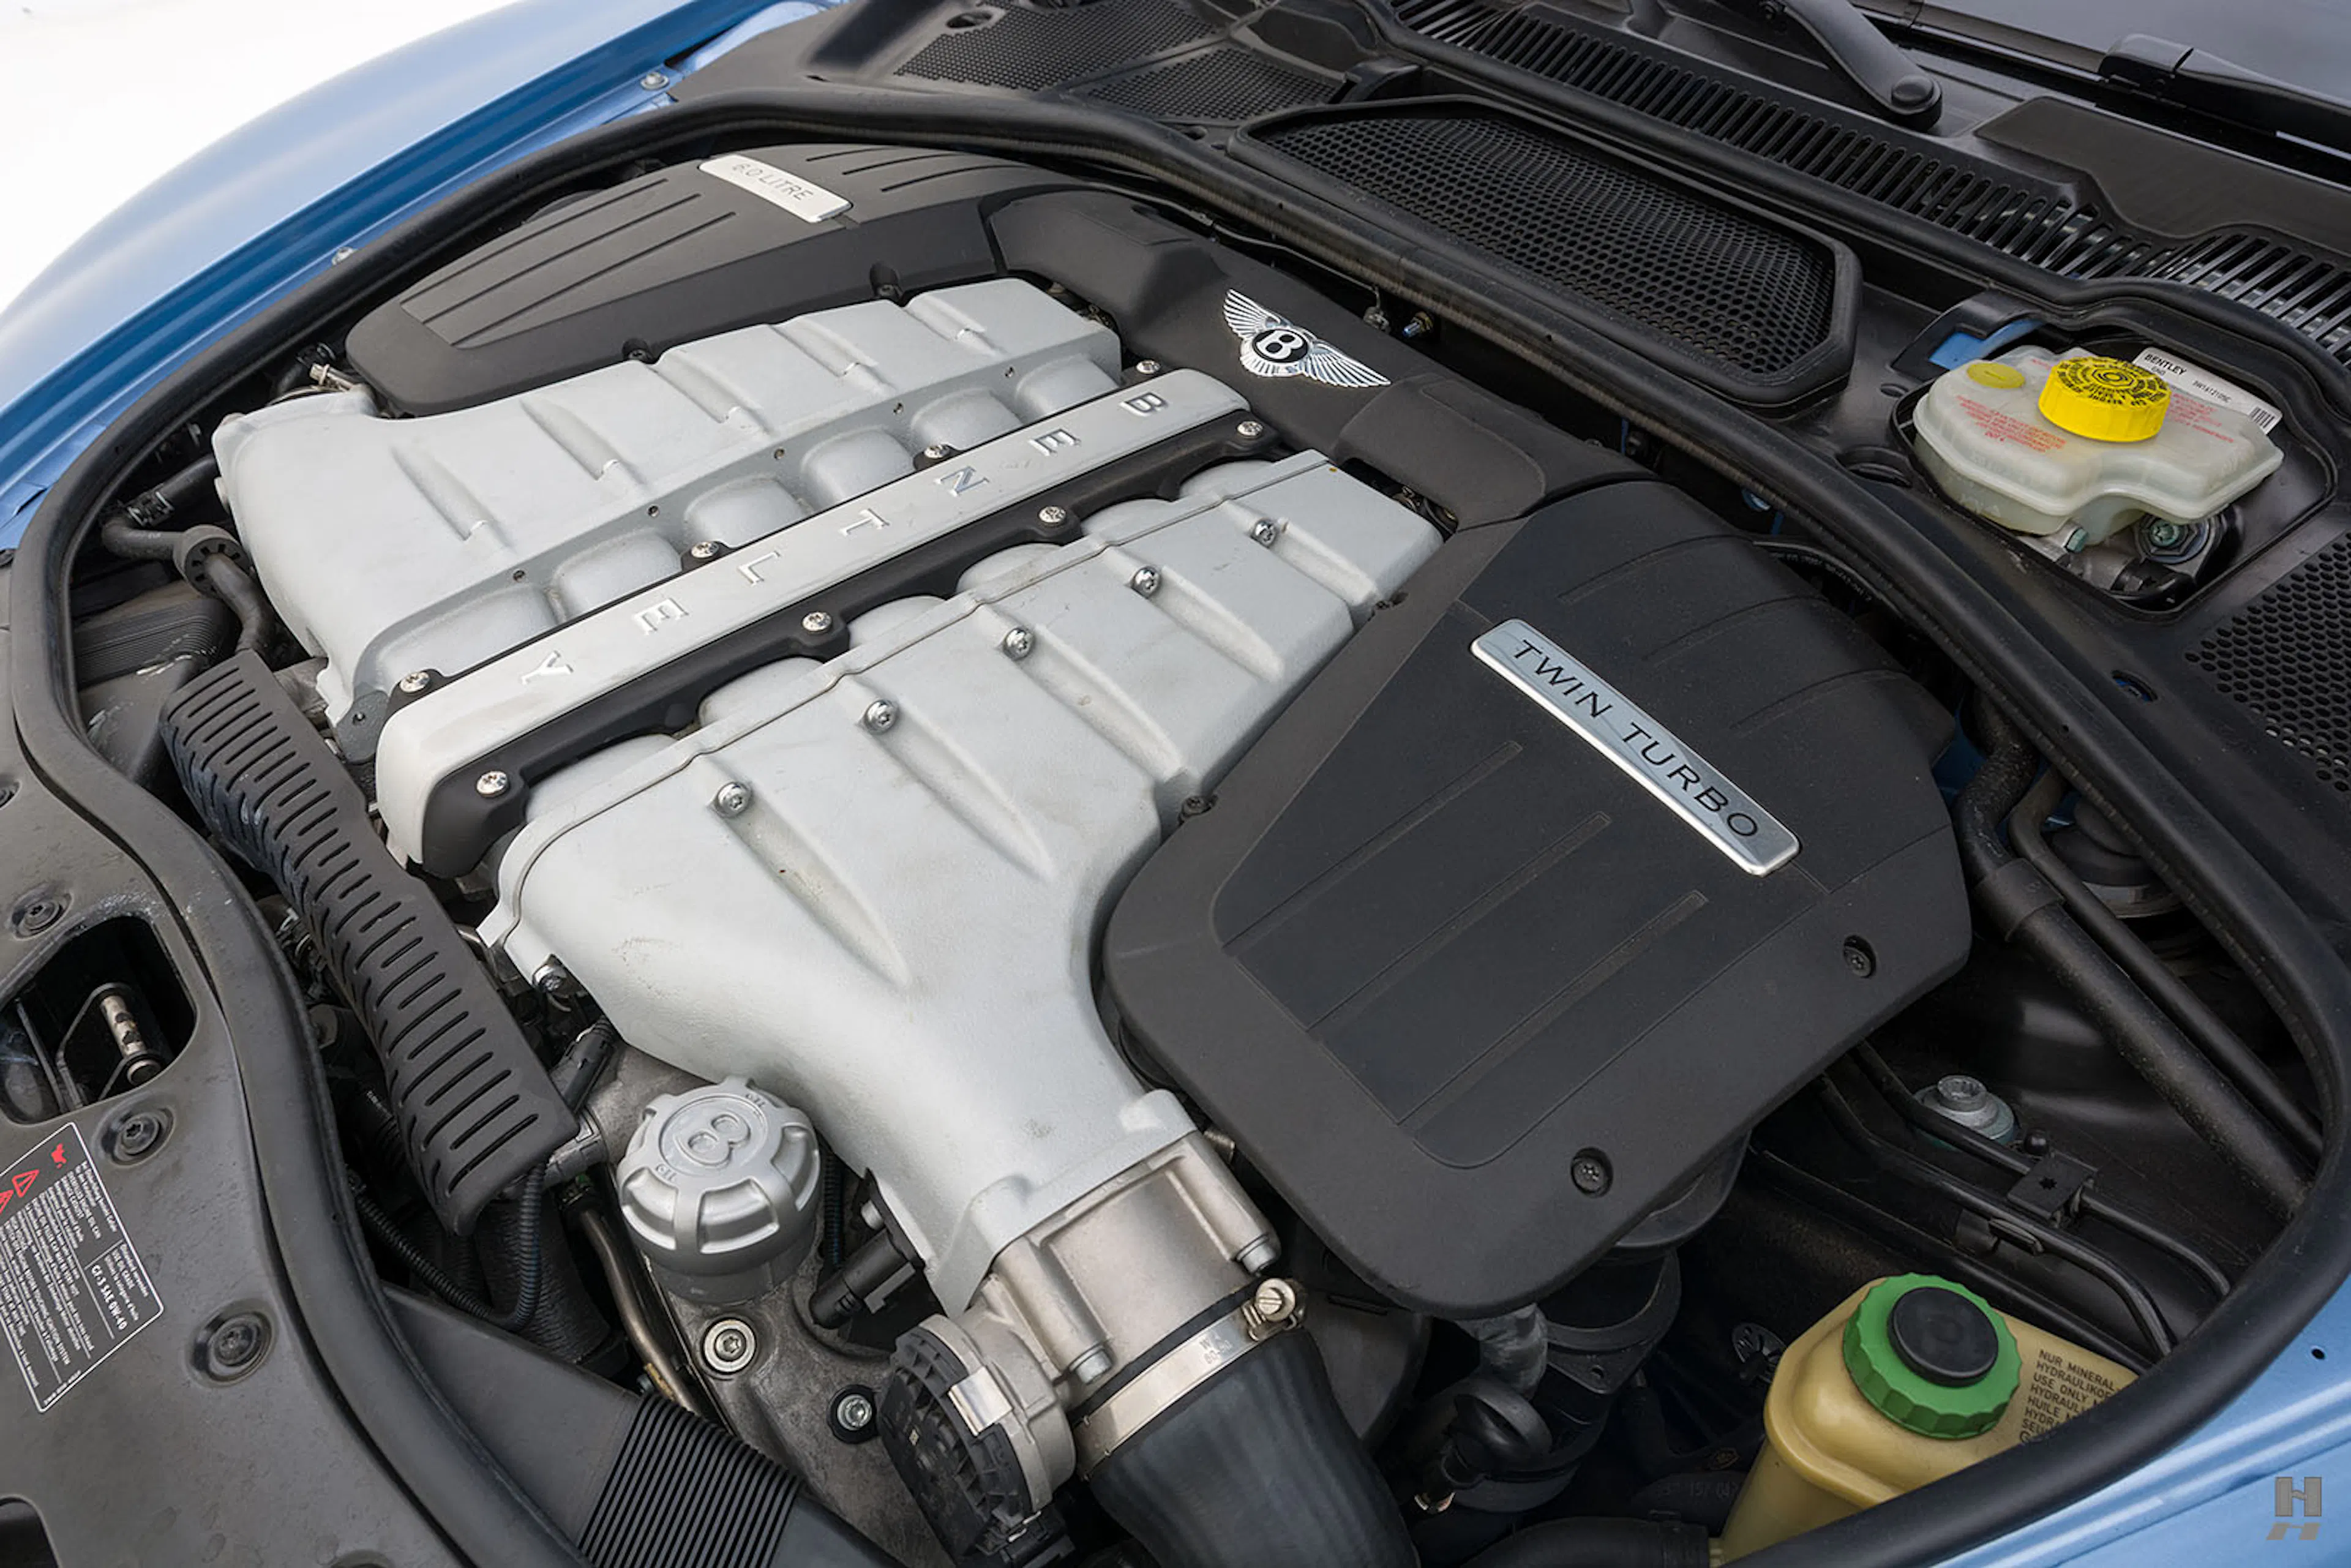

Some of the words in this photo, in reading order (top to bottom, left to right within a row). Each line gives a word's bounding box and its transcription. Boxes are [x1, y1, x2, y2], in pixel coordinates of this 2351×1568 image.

[758, 174, 814, 201] LITRE
[1256, 329, 1303, 360] B
[2145, 353, 2187, 375] BENTLEY
[1512, 639, 1614, 719] TWIN
[1622, 722, 1758, 838] TURBO
[100, 1283, 114, 1304] SAE
[2039, 1349, 2063, 1367] NUR
[2068, 1362, 2115, 1392] MINERAL
[2030, 1384, 2082, 1413] HYDRAUL
[2033, 1373, 2055, 1389] USE
[2060, 1384, 2088, 1403] ONLY
[2025, 1407, 2058, 1427] HYDR
[2028, 1395, 2061, 1418] HUILE
